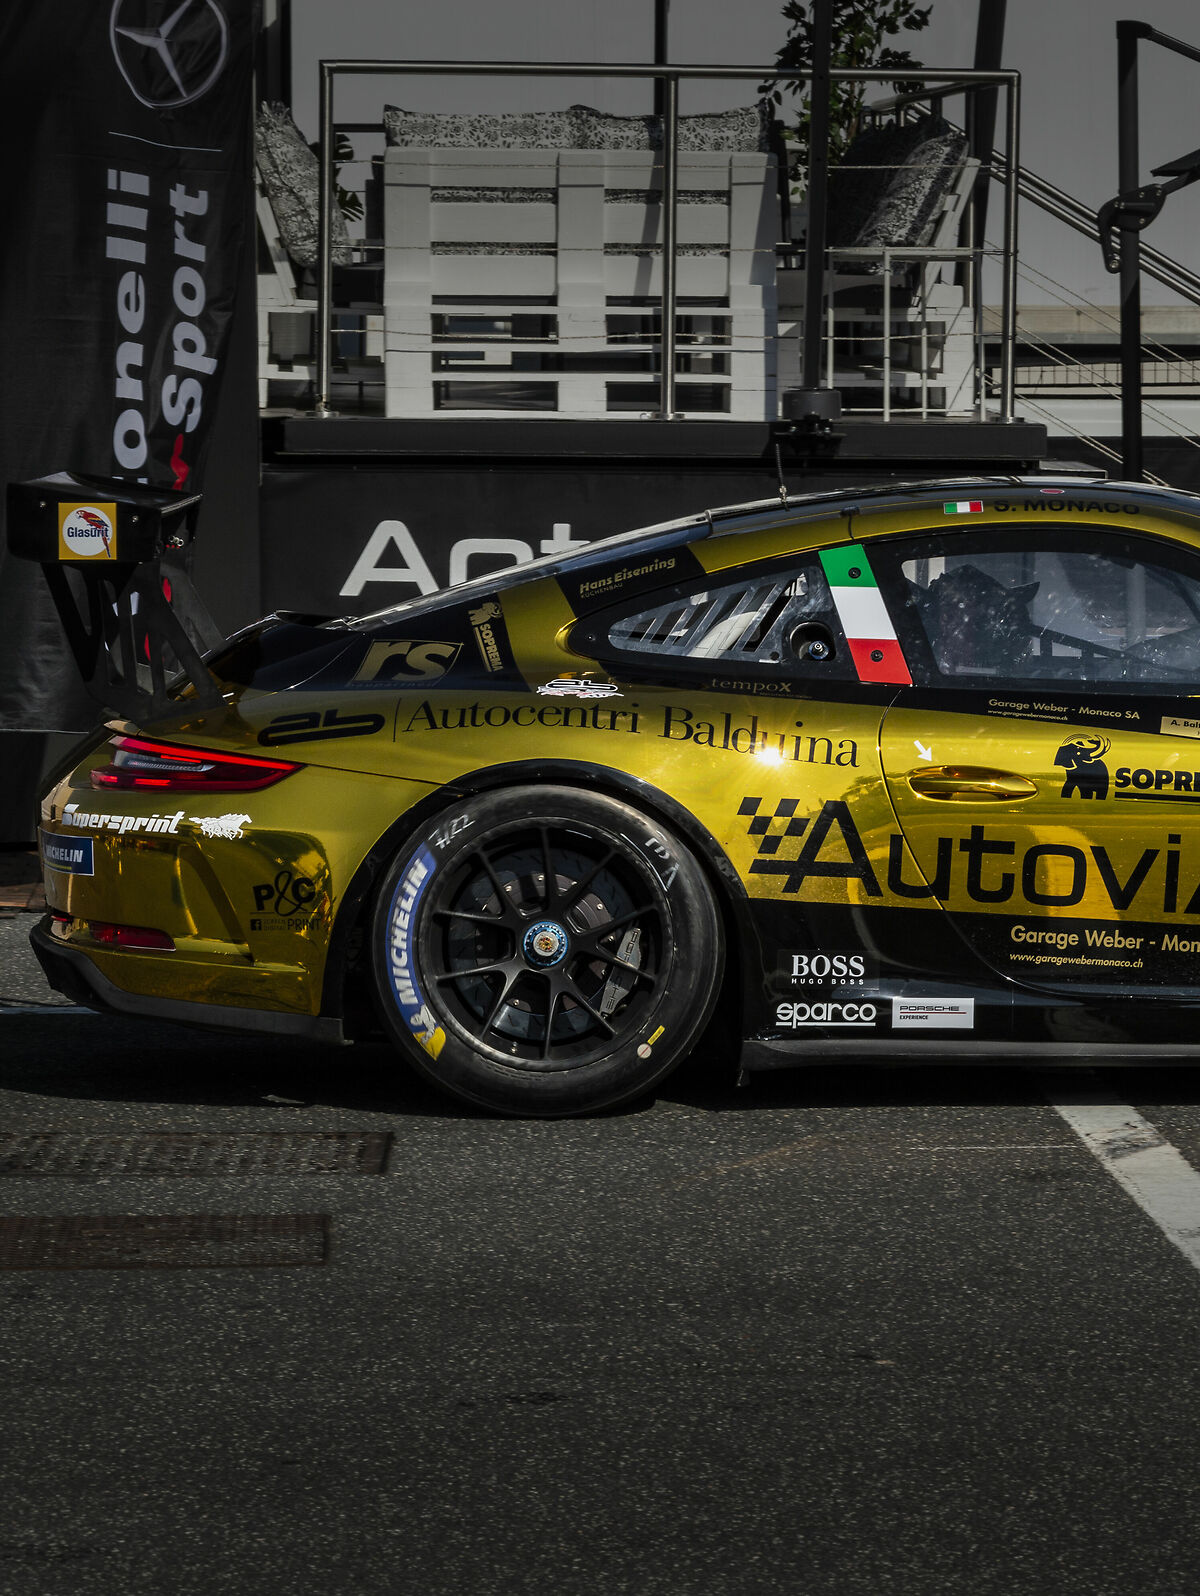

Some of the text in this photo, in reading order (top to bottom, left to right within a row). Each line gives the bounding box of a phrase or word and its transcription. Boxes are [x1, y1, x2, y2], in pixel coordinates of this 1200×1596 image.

[161, 182, 218, 433] Sport
[105, 168, 150, 485] onelli
[993, 499, 1141, 515] S. MONACO
[67, 526, 109, 538] Glasurit
[580, 557, 676, 594] Hans Eisenring
[352, 641, 456, 681] rs
[988, 698, 1030, 711] Garage
[1032, 702, 1069, 713] Weber
[1078, 706, 1122, 719] Monaco
[1124, 710, 1141, 720] SA
[1170, 718, 1181, 727] A.
[402, 700, 860, 768] Autocentri Balduina
[62, 803, 186, 835] Supersprint
[253, 870, 316, 917] P&C
[391, 858, 429, 1006] MICHELIN
[1010, 924, 1080, 950] Garage
[1085, 929, 1144, 950] Weber
[791, 954, 865, 977] BOSS
[1009, 951, 1144, 969] www.garagewebermonaco.ch
[831, 978, 864, 986] BOSS
[775, 1001, 878, 1029] sparco
